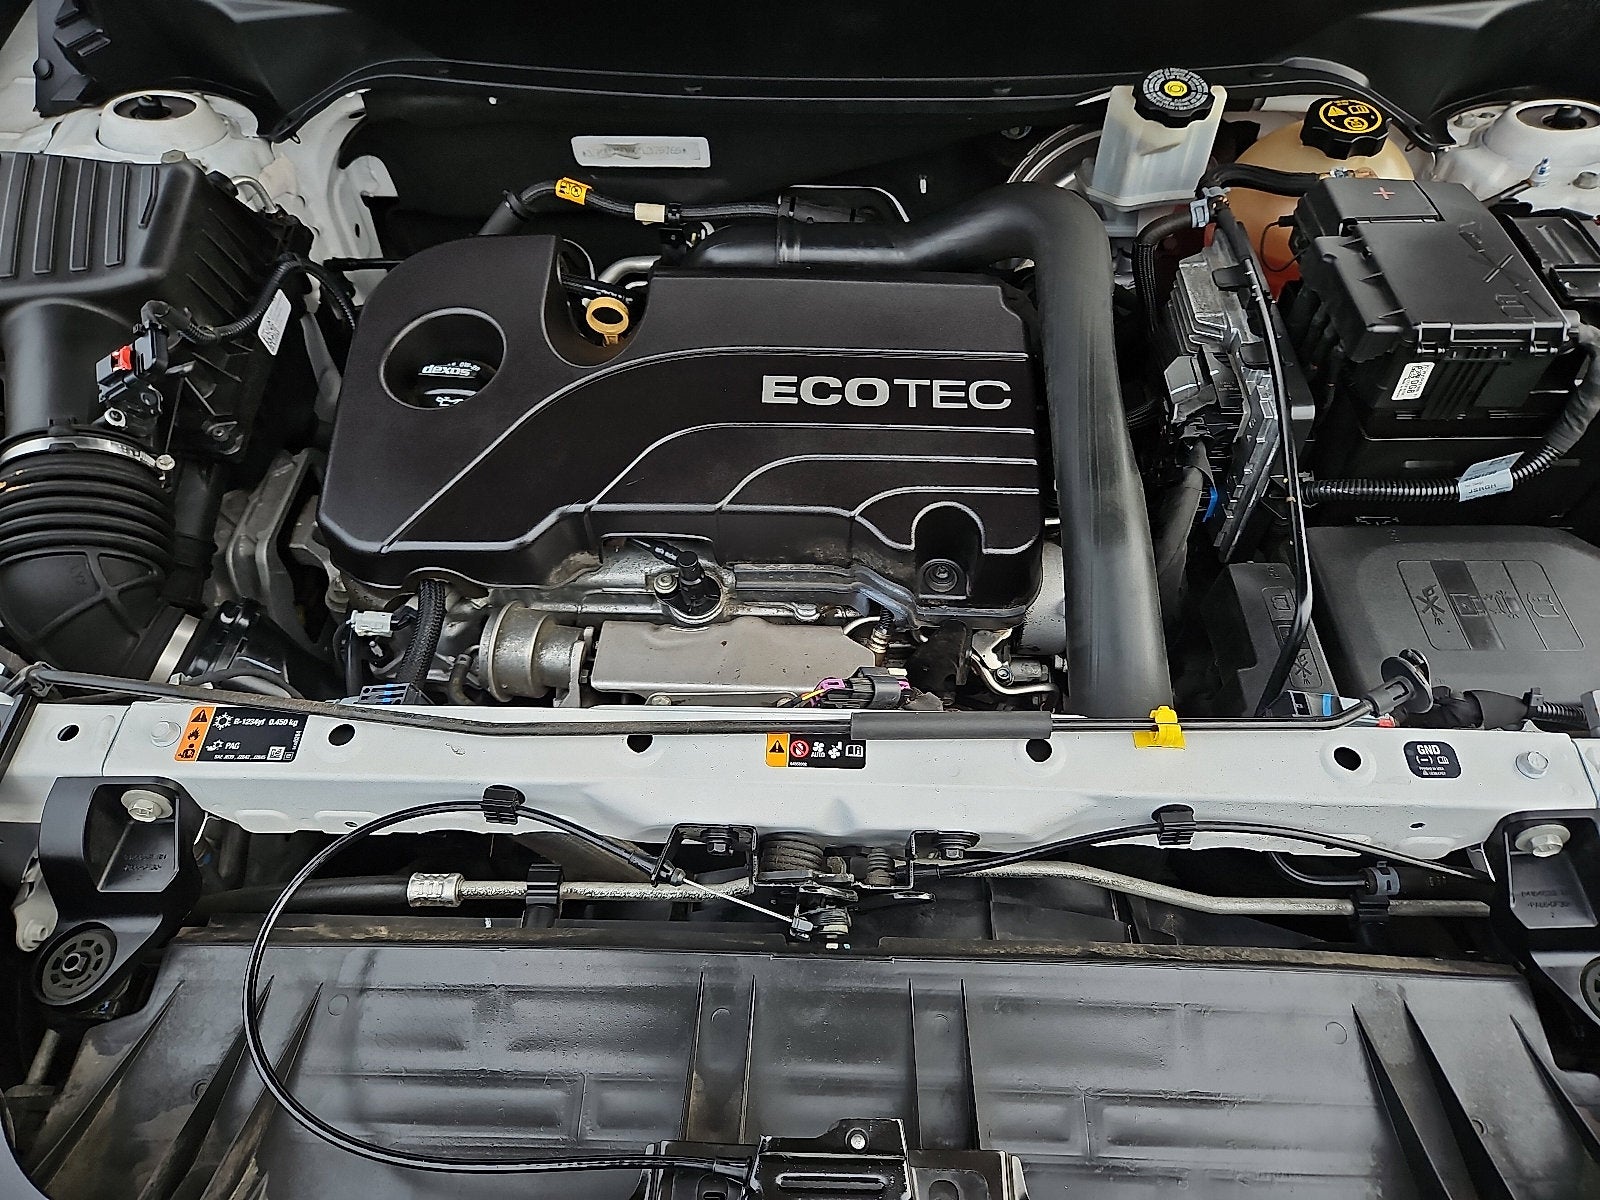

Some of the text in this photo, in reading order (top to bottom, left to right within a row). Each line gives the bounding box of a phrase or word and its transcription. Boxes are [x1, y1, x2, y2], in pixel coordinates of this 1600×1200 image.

[421, 364, 471, 376] dexos
[761, 374, 1012, 410] ECOTEC
[268, 718, 288, 726] 0.450
[288, 718, 298, 727] kg
[1416, 744, 1441, 755] GND
